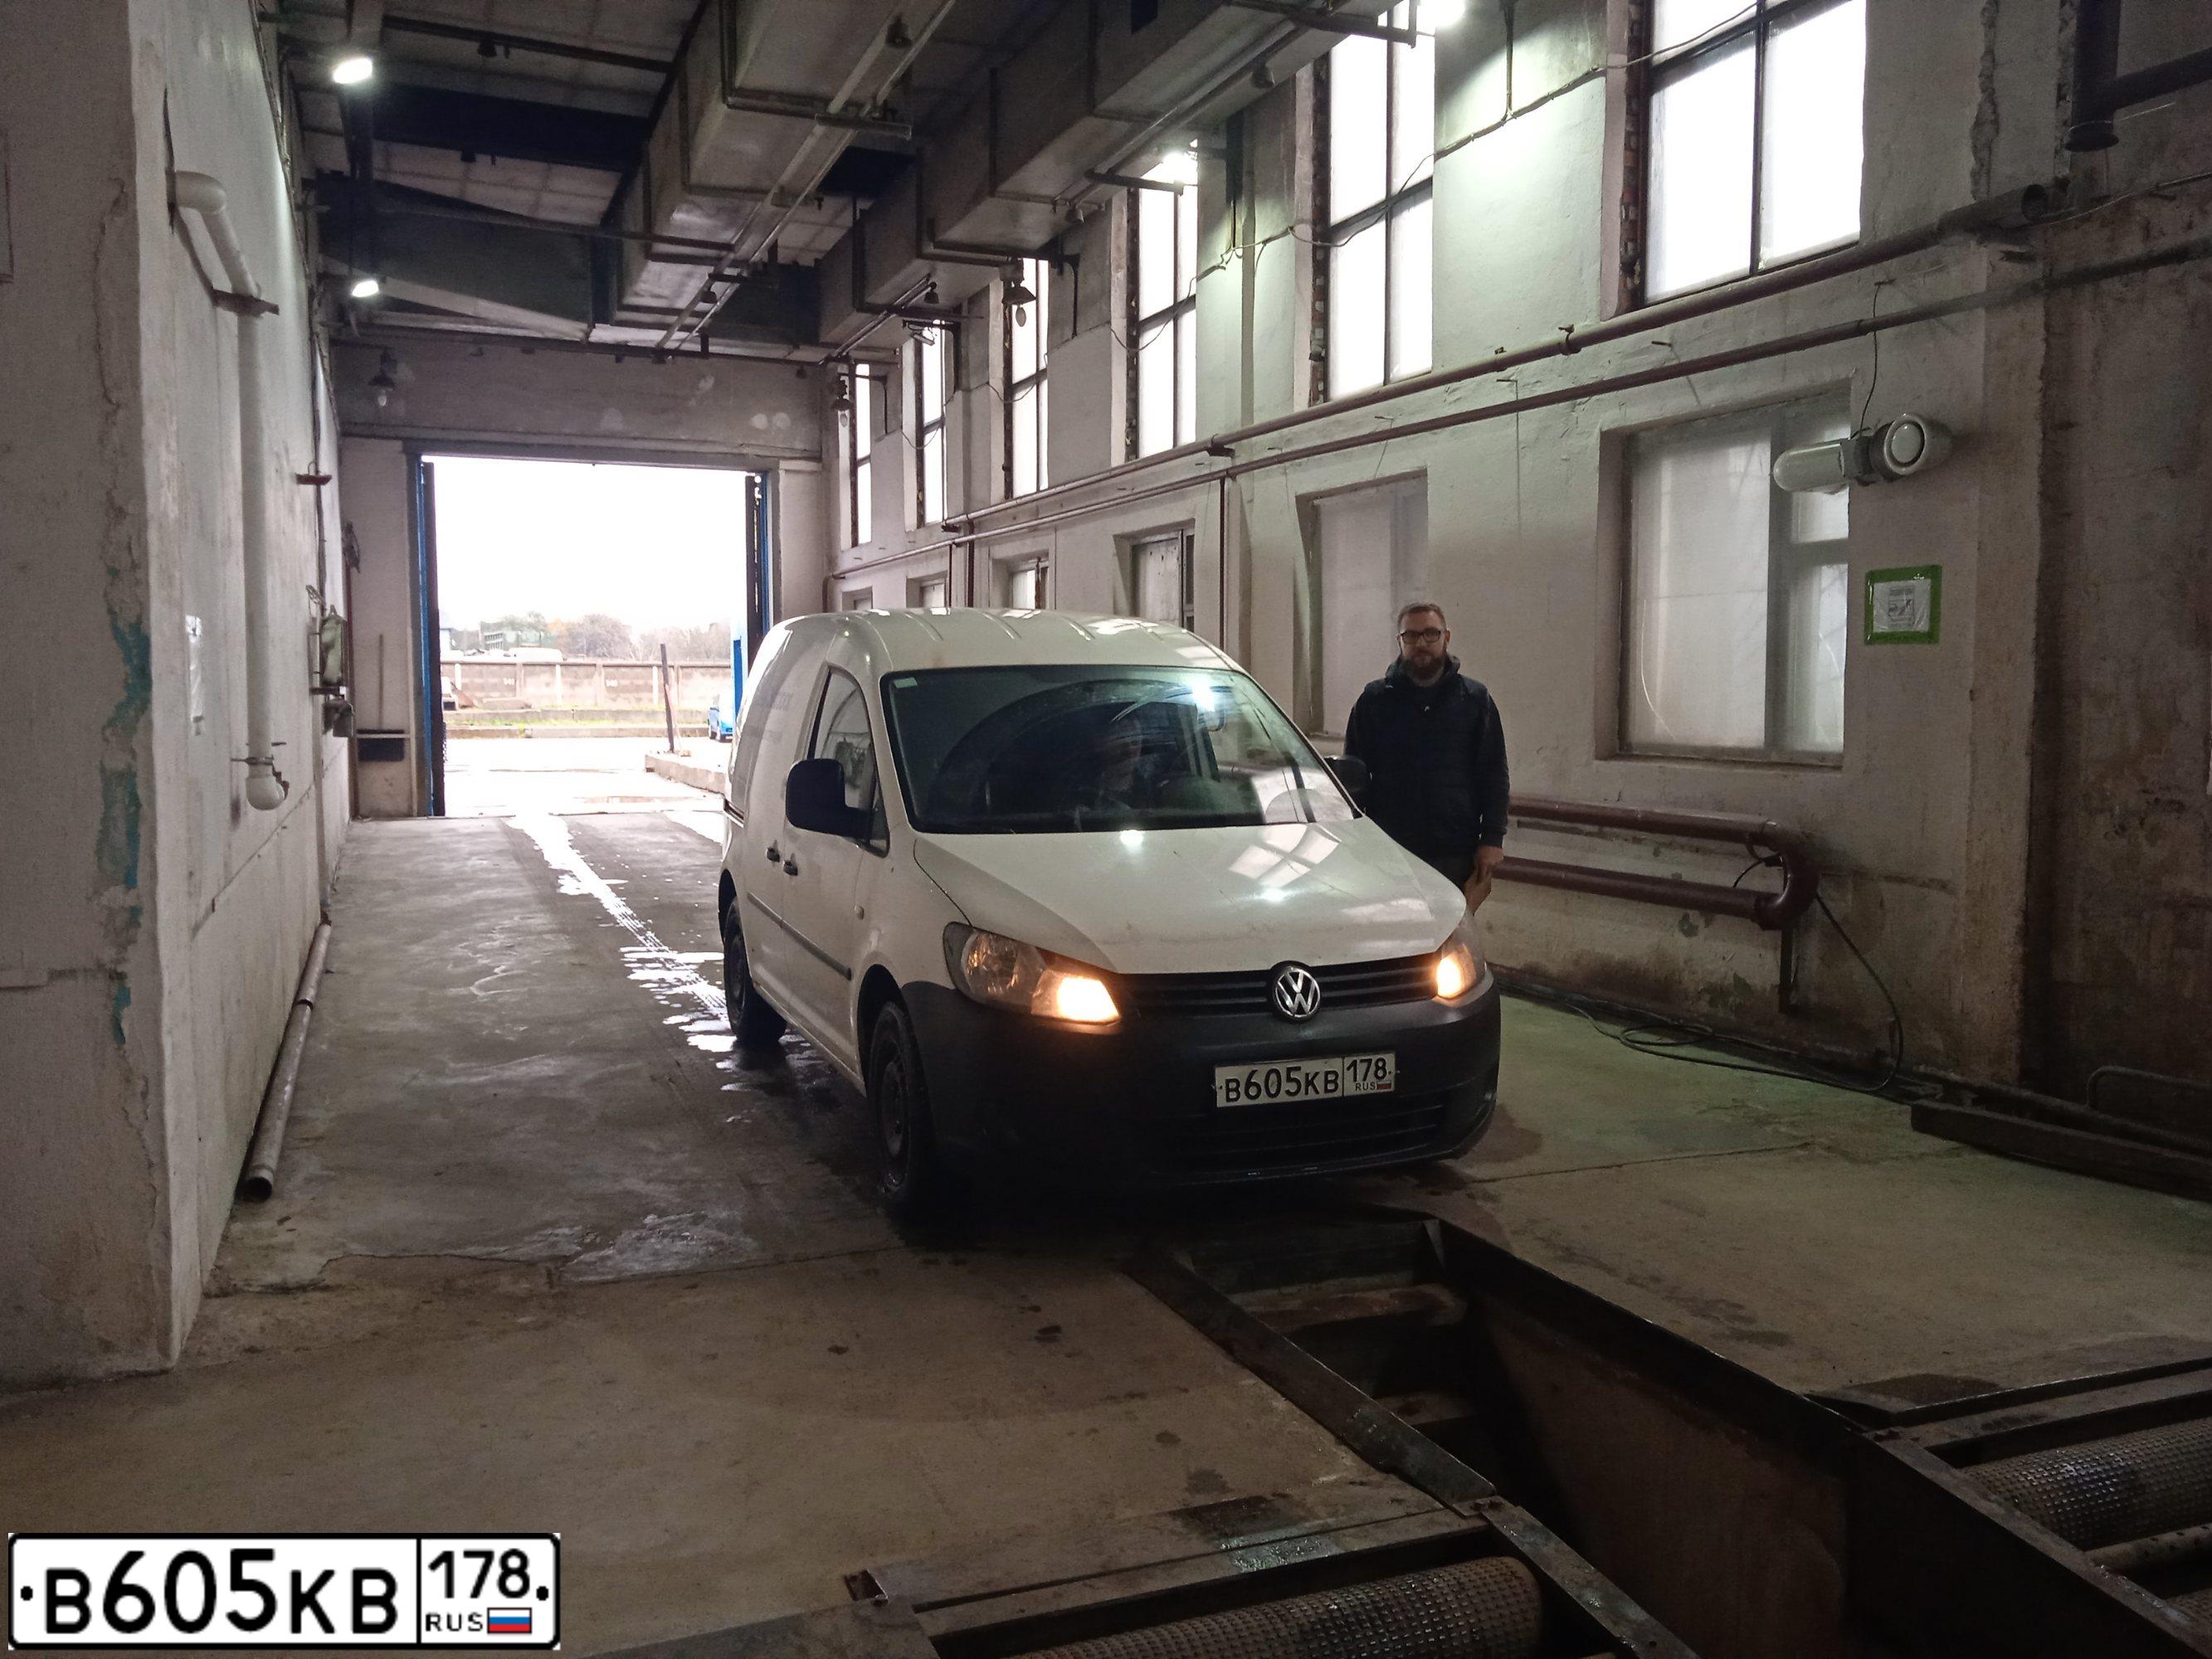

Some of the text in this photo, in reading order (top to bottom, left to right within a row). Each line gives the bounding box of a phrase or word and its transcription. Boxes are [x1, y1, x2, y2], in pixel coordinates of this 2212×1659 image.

[1224, 1057, 1387, 1102] В605КВ 178
[1355, 1081, 1376, 1091] RUS
